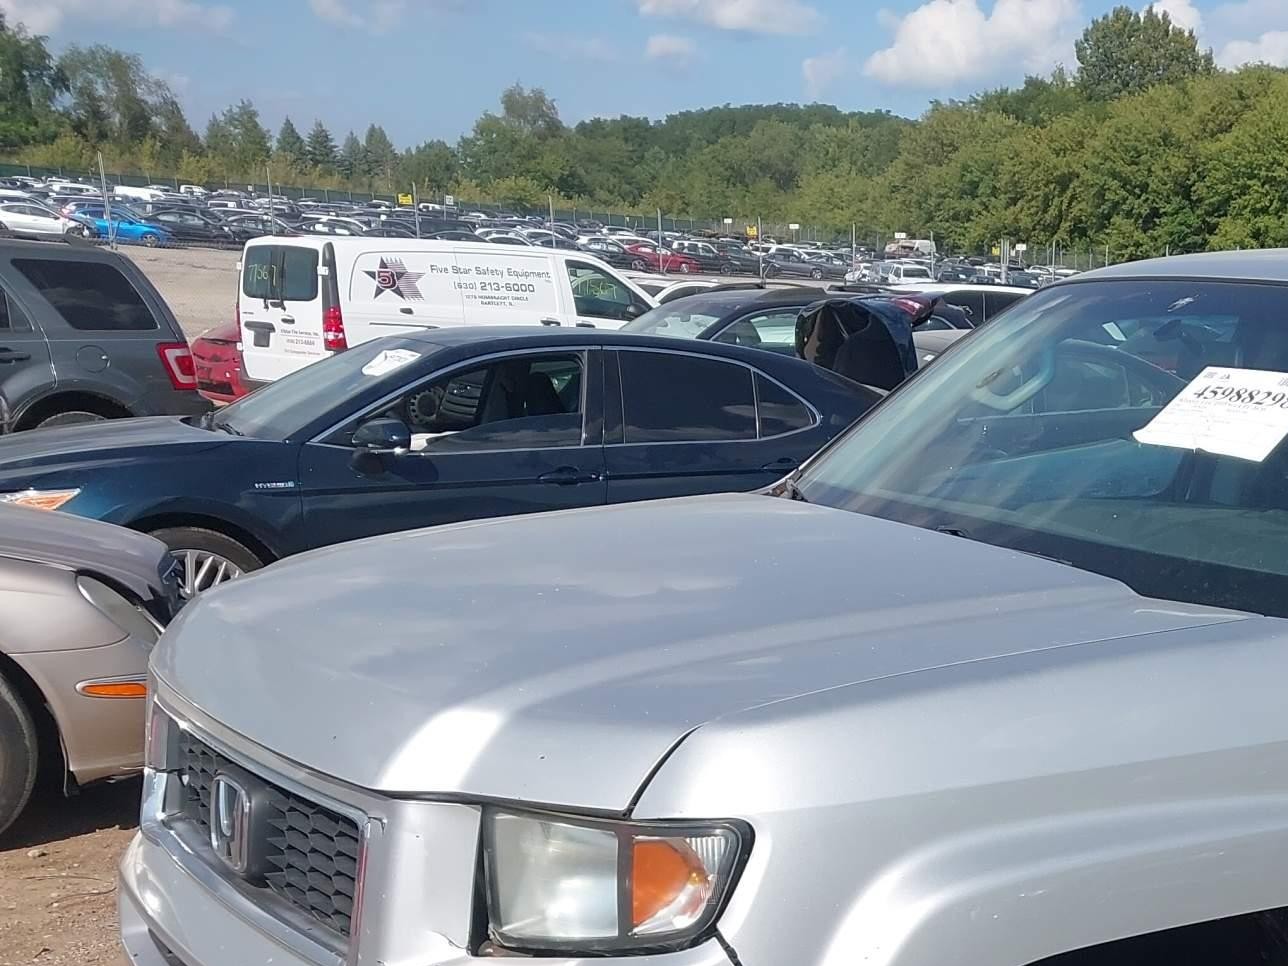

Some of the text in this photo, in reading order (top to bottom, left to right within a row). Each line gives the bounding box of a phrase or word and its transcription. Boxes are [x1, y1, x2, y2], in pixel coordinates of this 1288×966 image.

[377, 269, 397, 290] 5
[430, 264, 551, 280] Five Star Safety Equipment
[453, 281, 477, 291] (630)
[480, 281, 535, 293] 213-6000
